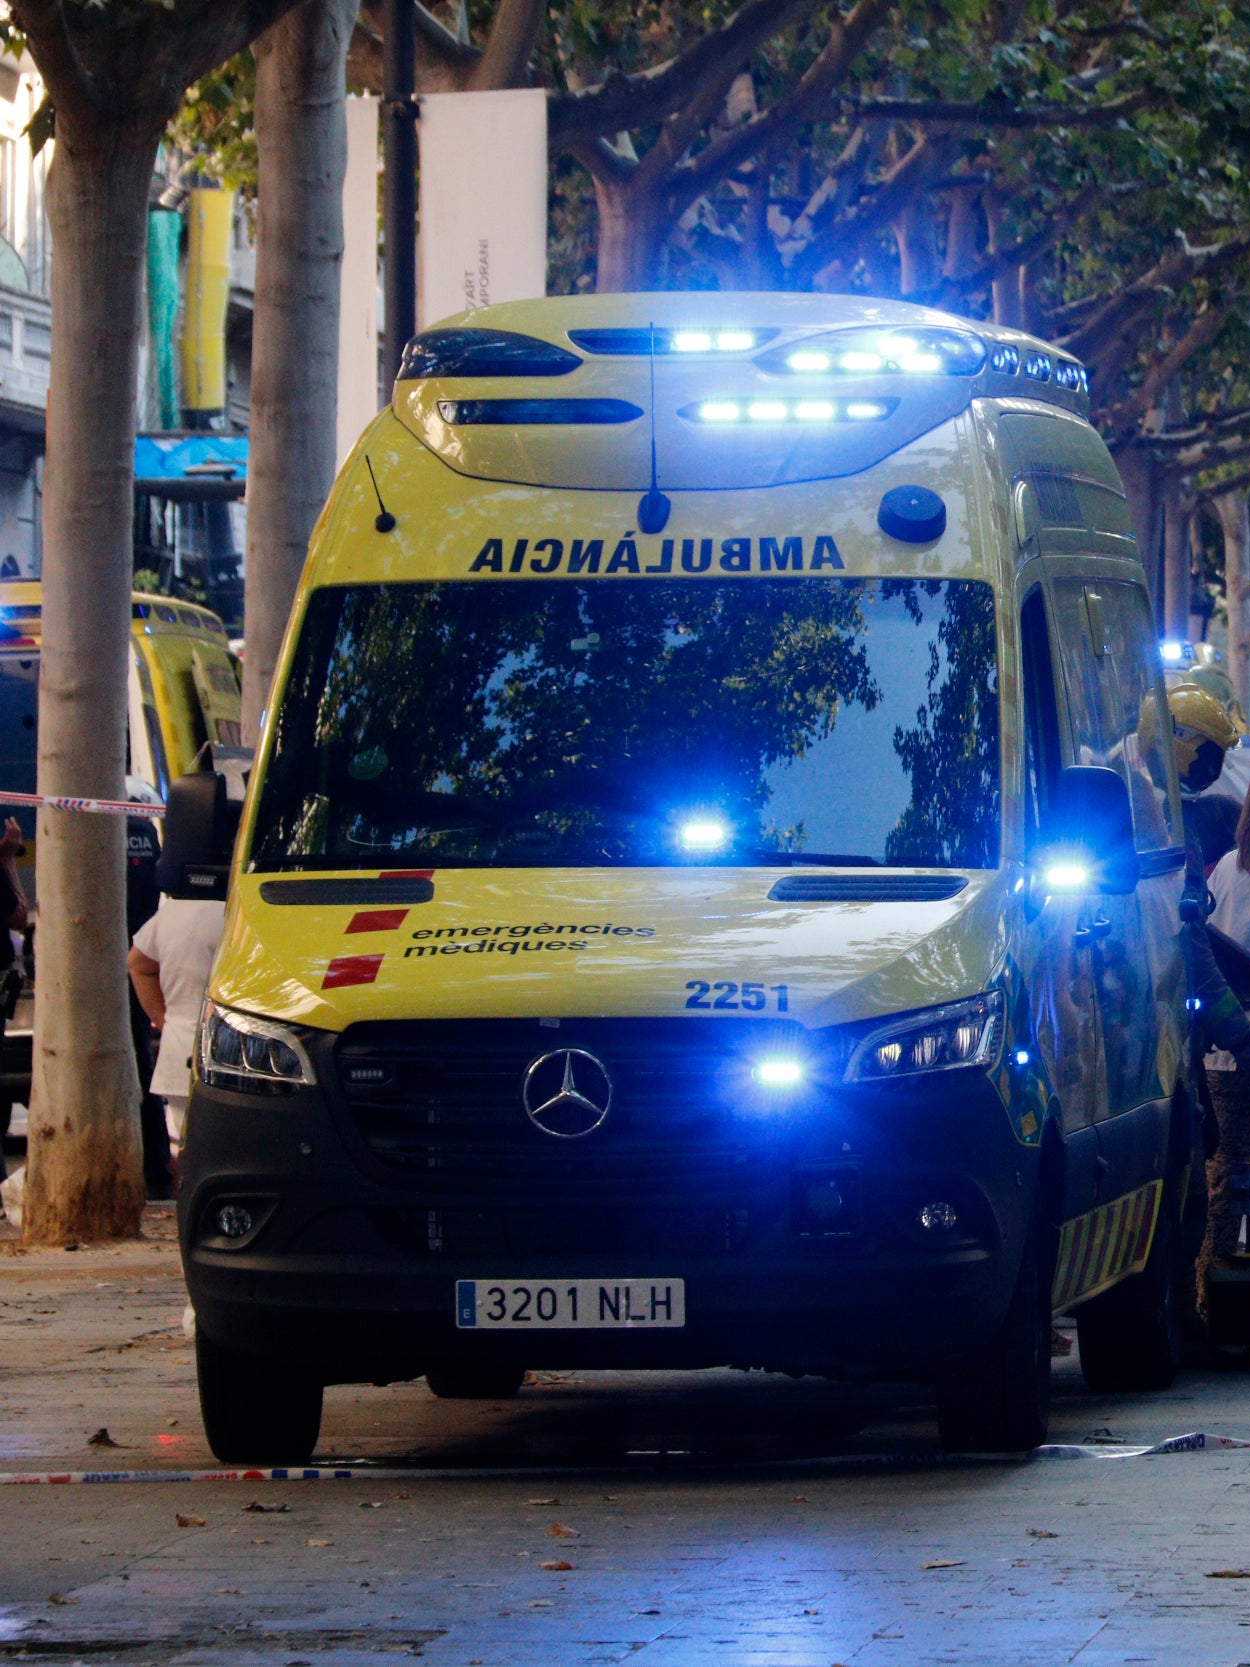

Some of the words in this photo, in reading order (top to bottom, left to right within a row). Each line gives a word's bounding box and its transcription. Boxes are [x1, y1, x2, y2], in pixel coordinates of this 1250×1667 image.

[411, 921, 656, 940] emergències
[403, 938, 589, 958] mèdiques
[685, 980, 789, 1012] 2251
[462, 1308, 471, 1319] E
[486, 1286, 578, 1321] 3201
[600, 1286, 672, 1321] NLH
